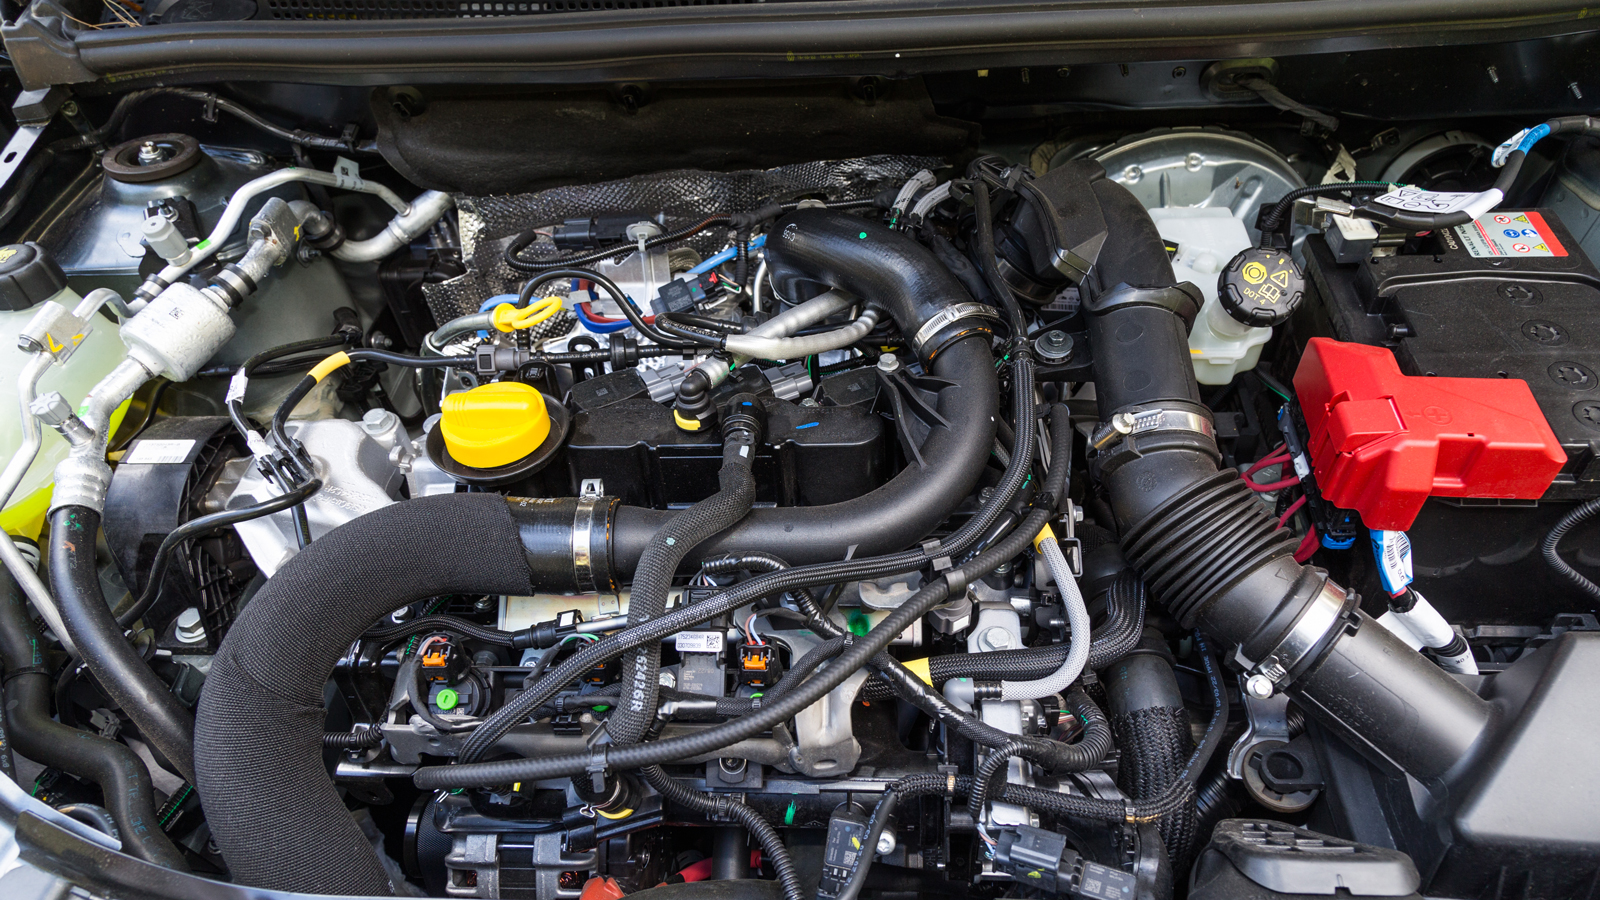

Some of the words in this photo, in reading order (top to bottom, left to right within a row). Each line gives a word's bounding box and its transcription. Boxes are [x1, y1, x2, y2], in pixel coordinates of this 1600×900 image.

[1243, 287, 1261, 301] DOT
[1200, 641, 1207, 652] IN
[1203, 654, 1213, 674] MADE
[863, 799, 884, 840] 03/03/22
